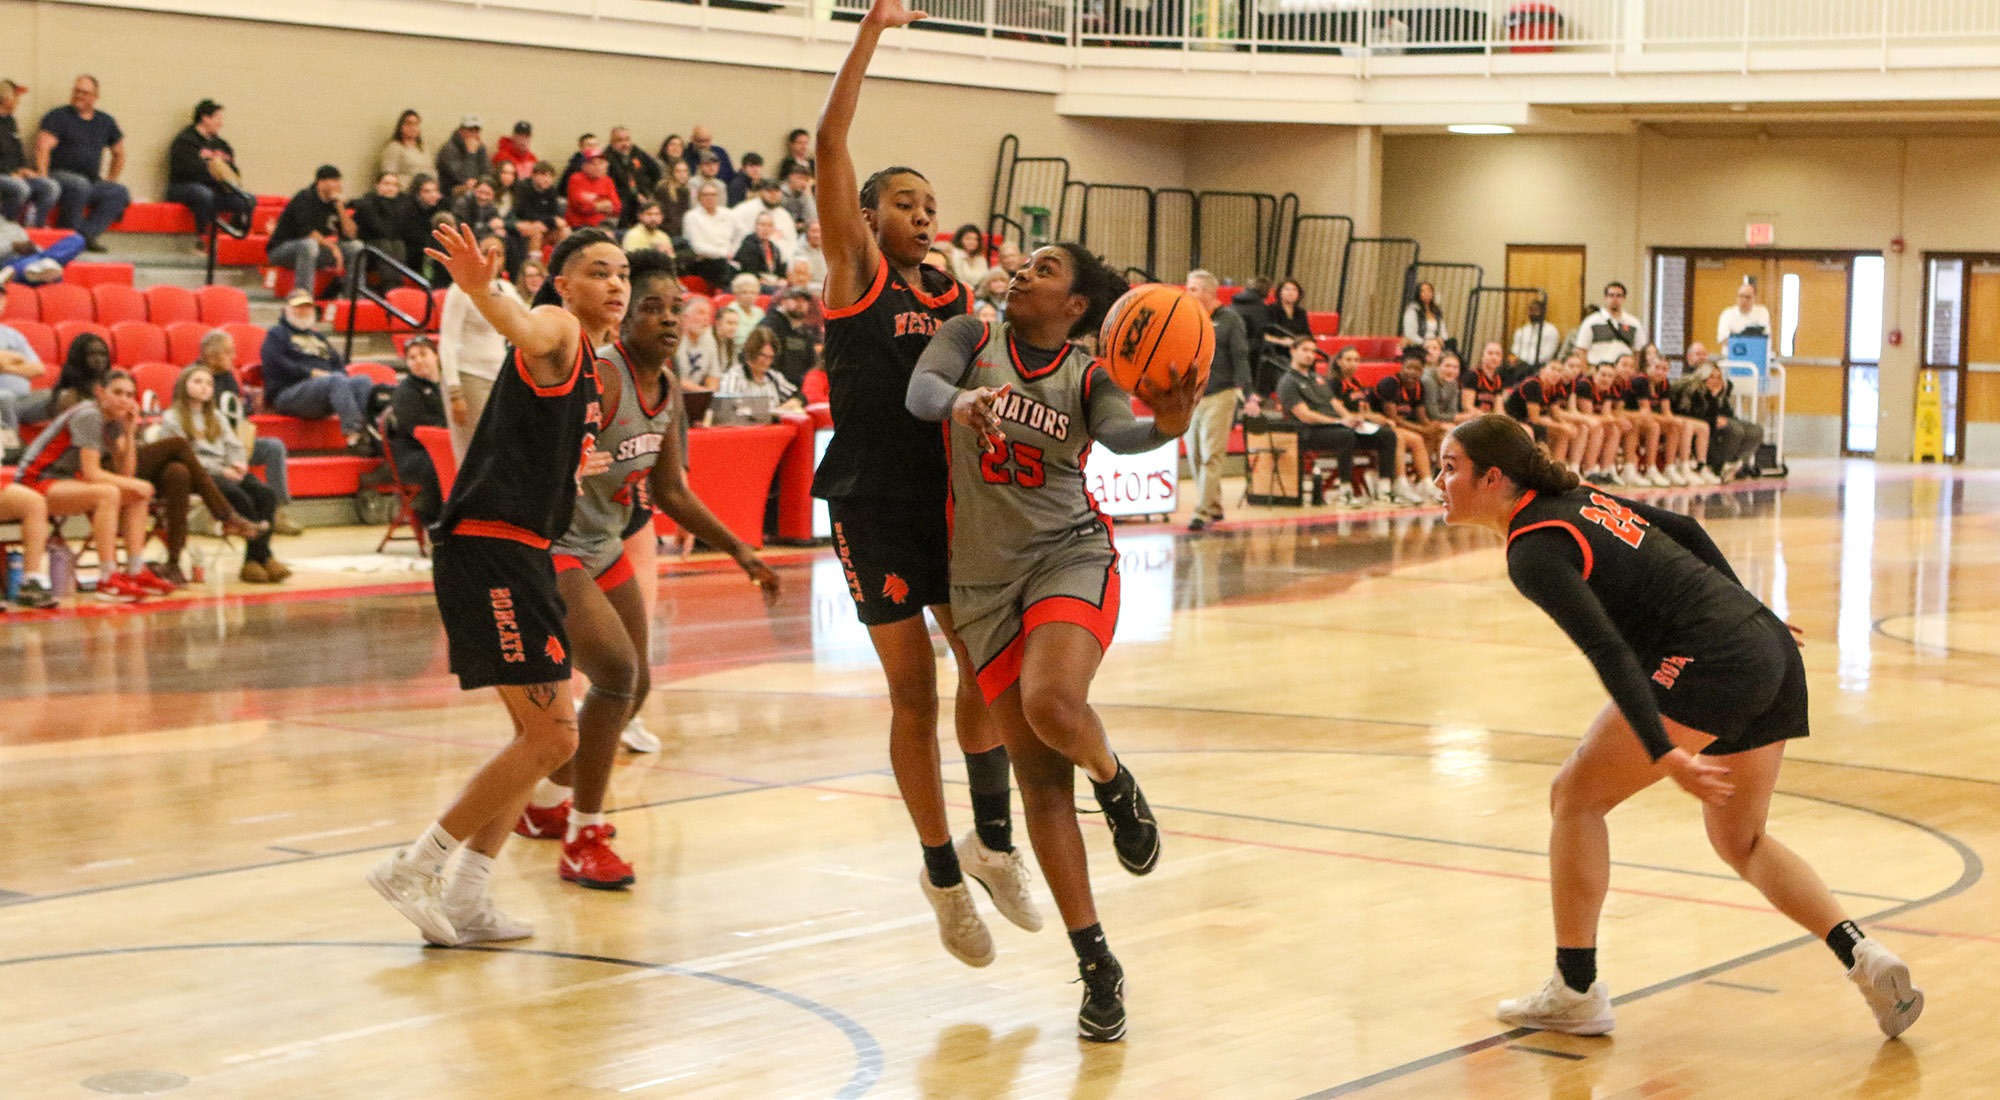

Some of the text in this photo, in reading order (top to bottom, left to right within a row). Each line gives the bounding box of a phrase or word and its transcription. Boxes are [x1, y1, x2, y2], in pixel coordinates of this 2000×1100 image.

[1119, 305, 1156, 362] NCAA
[979, 432, 1045, 488] 25
[1579, 492, 1650, 549] 24
[489, 587, 525, 663] BOBCATS
